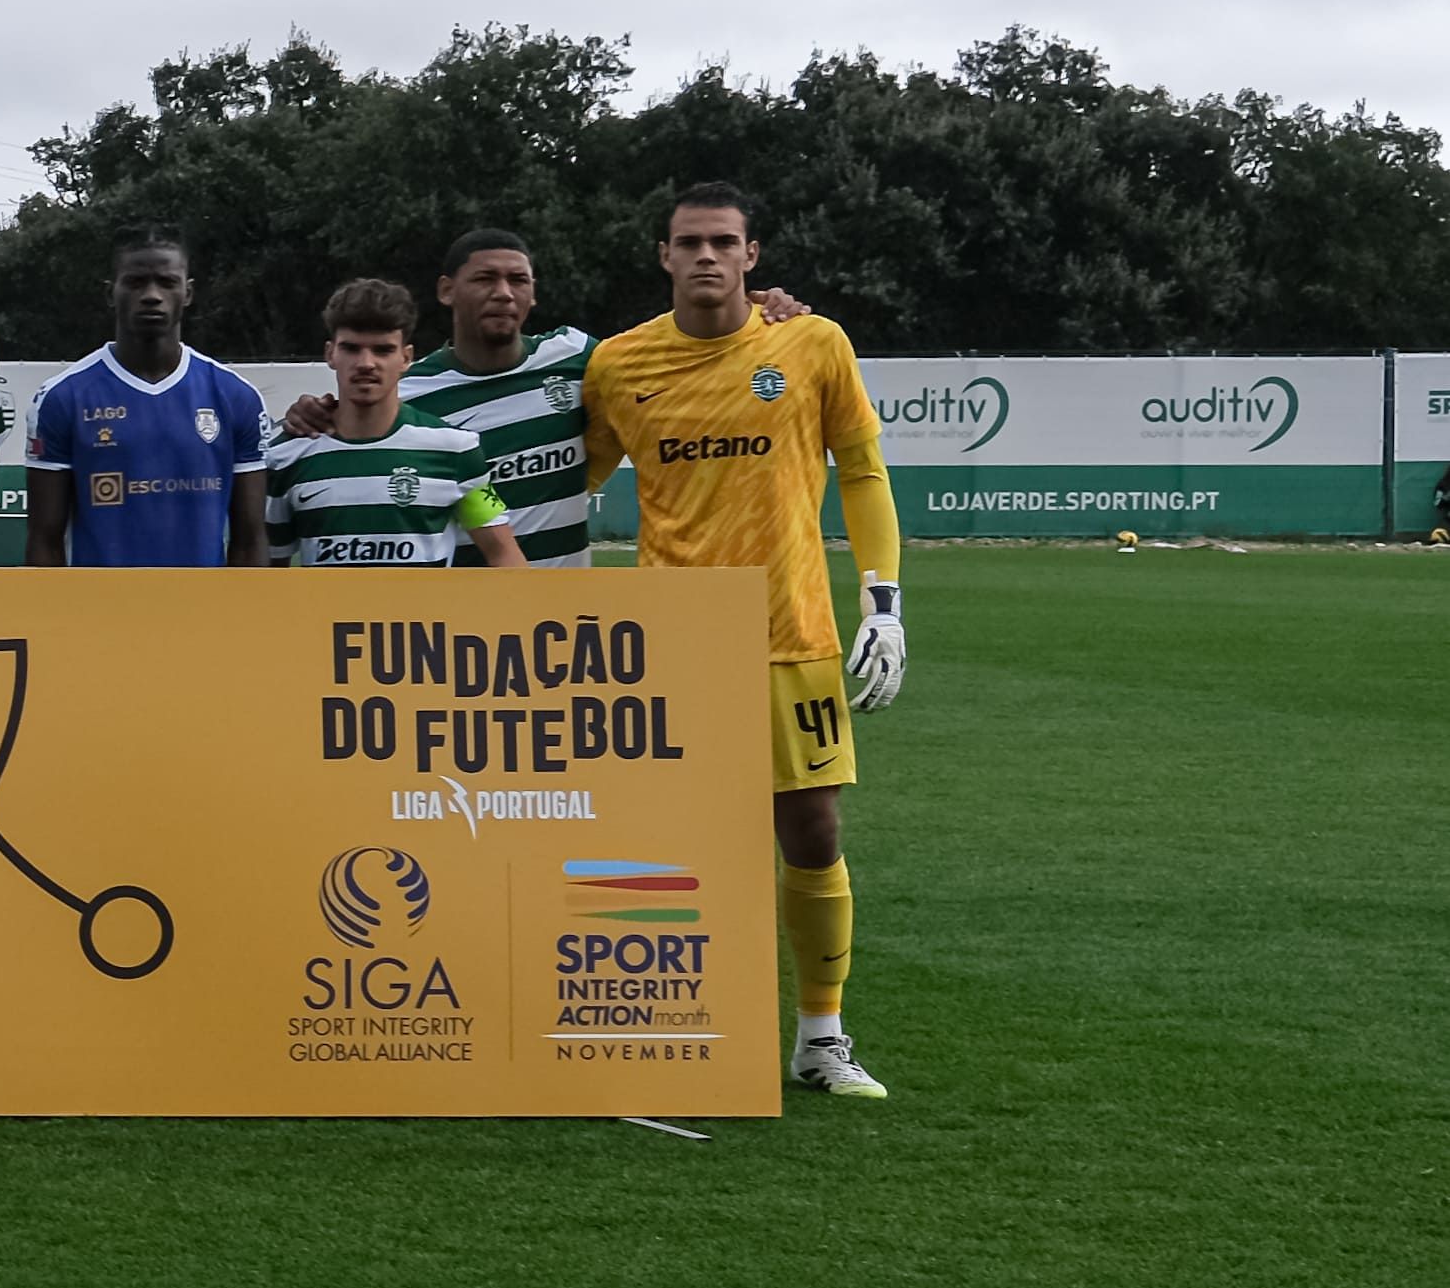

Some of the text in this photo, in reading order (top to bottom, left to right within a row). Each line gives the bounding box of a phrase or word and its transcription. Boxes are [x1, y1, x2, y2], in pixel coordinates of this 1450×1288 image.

[83, 406, 126, 422] LAGO
[872, 387, 987, 423] uditiv
[1141, 386, 1274, 423] auditiv
[658, 434, 772, 464] Betano
[128, 477, 222, 494] ESC ONLINE
[927, 490, 1220, 512] LOJAVERDE.SPORTING.PT
[315, 537, 414, 563] Betano
[332, 614, 646, 698] FUNDAÇÃO
[321, 696, 684, 774] DO FUTEBOL
[795, 696, 839, 748] 41
[391, 790, 597, 820] LIGA PORTUGAL
[555, 934, 710, 975] SPORT
[302, 957, 462, 1010] SIGA
[557, 979, 703, 1001] INTEGRITY
[287, 1017, 475, 1036] SPORT INTEGRITY
[288, 1043, 474, 1062] GLOBAL ALLIANCE
[556, 1044, 711, 1061] NOVEMBER
